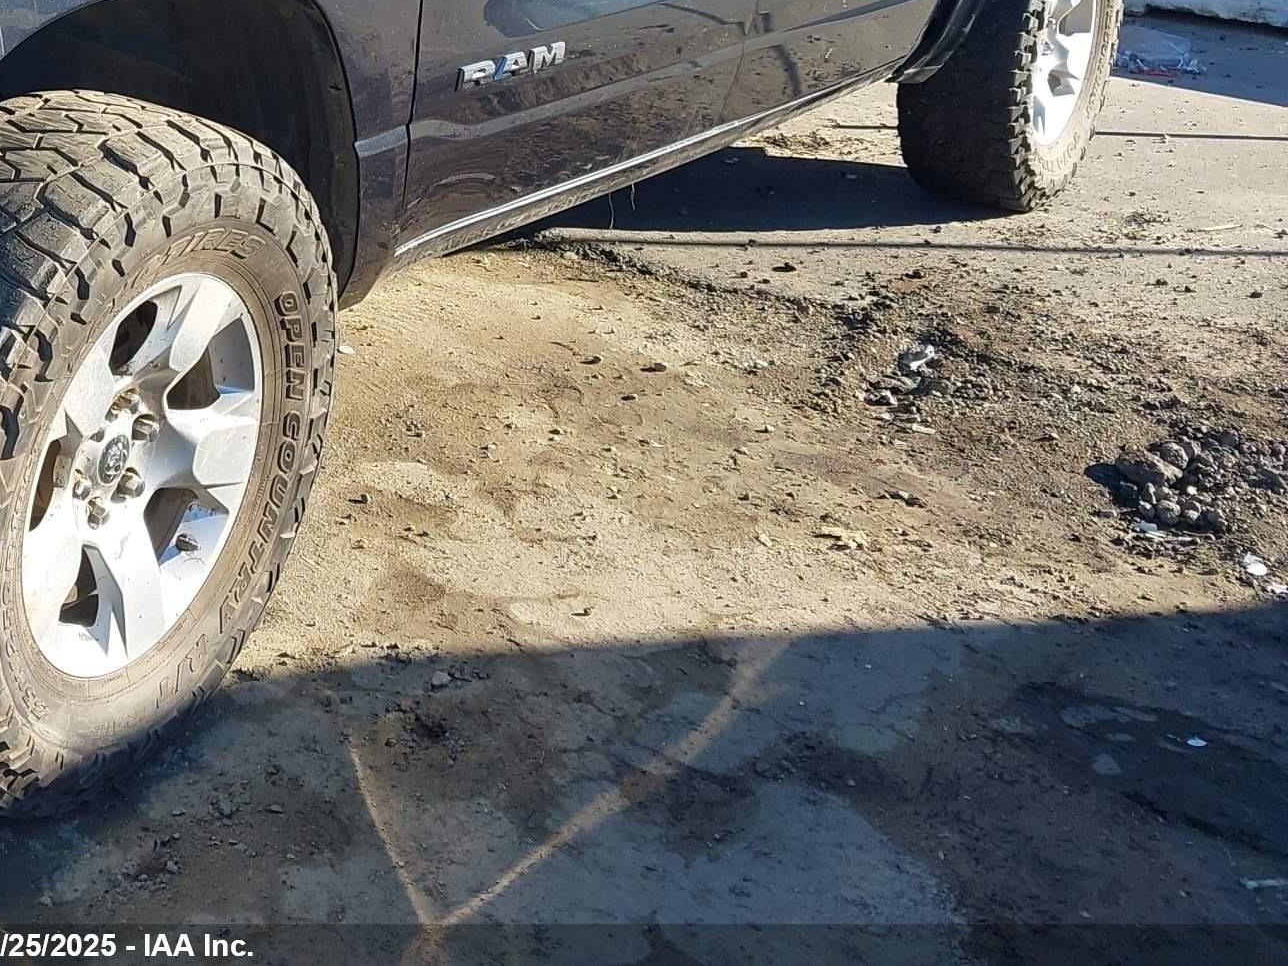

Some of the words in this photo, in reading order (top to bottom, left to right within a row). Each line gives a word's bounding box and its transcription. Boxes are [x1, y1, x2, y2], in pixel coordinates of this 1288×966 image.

[454, 41, 566, 92] RAM
[274, 290, 307, 401] OPEN
[218, 410, 302, 634] COUNTRY
